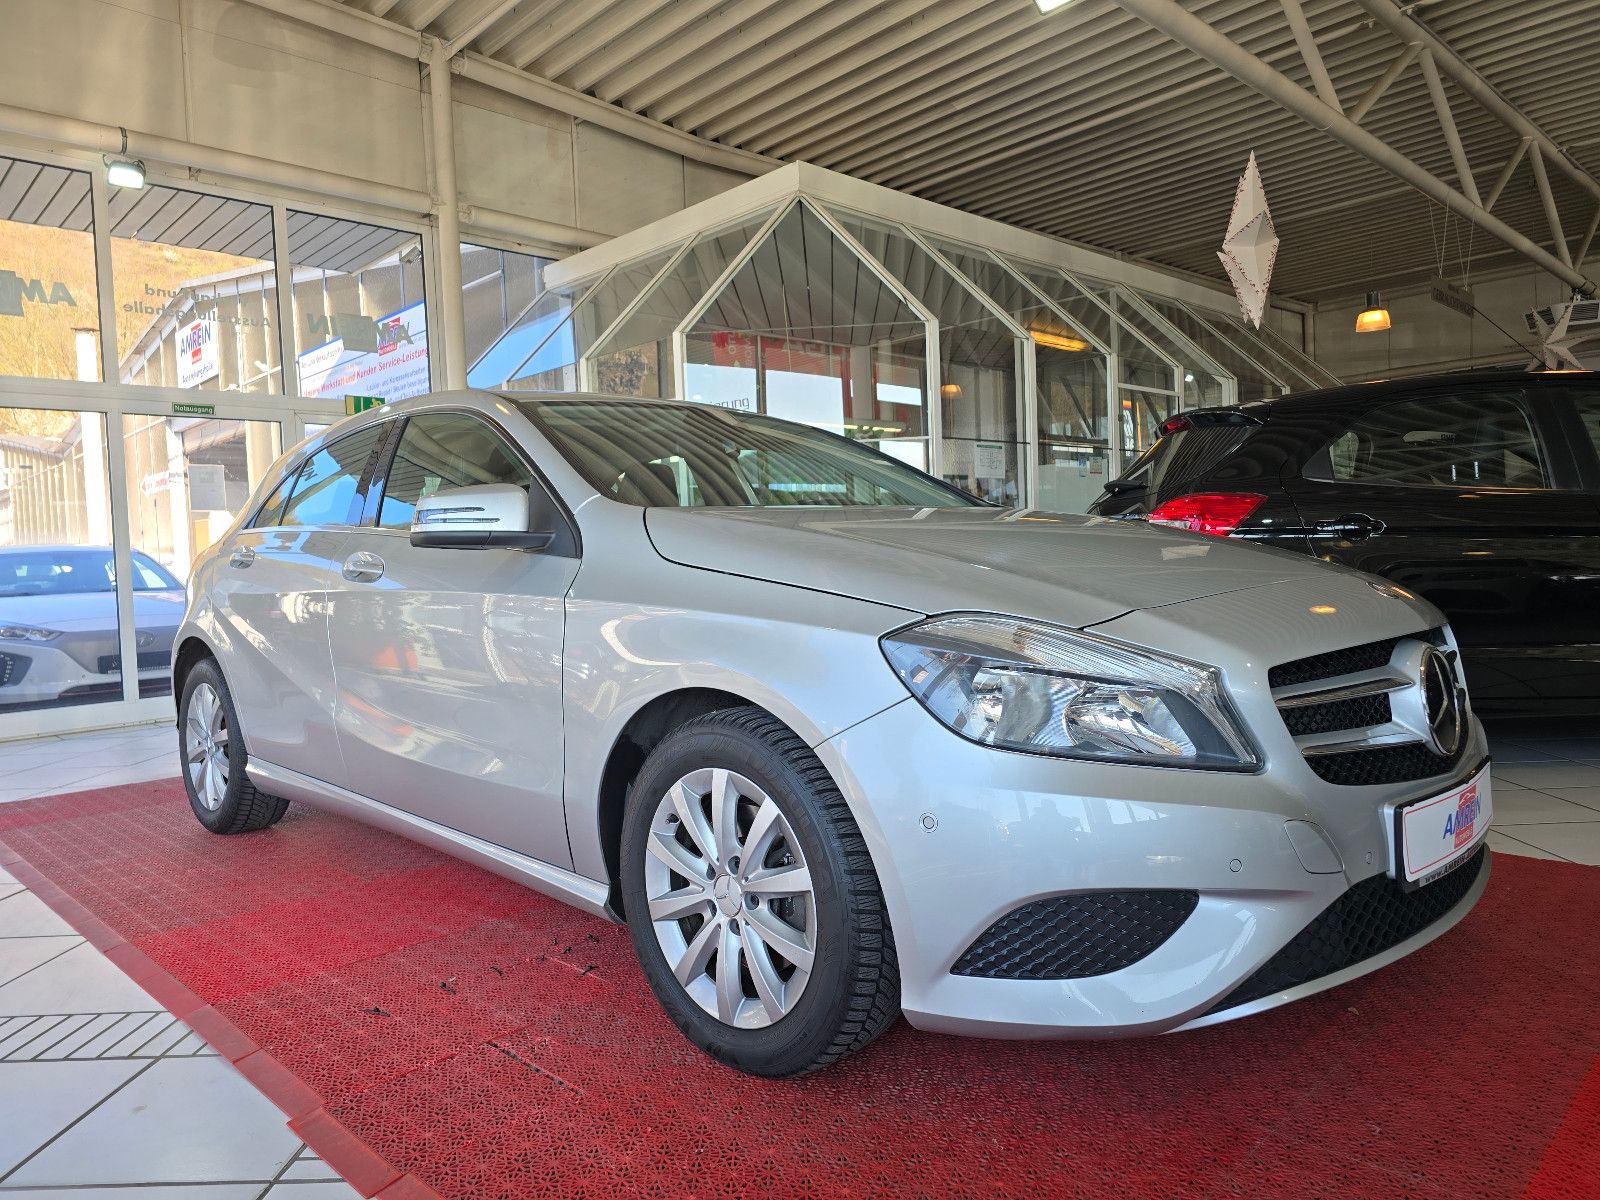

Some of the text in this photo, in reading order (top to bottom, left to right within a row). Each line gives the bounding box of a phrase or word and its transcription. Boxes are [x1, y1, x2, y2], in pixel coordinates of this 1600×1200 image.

[180, 321, 211, 357] AMREIN
[174, 404, 214, 414] Notausgang
[1443, 792, 1482, 840] AMREIN
